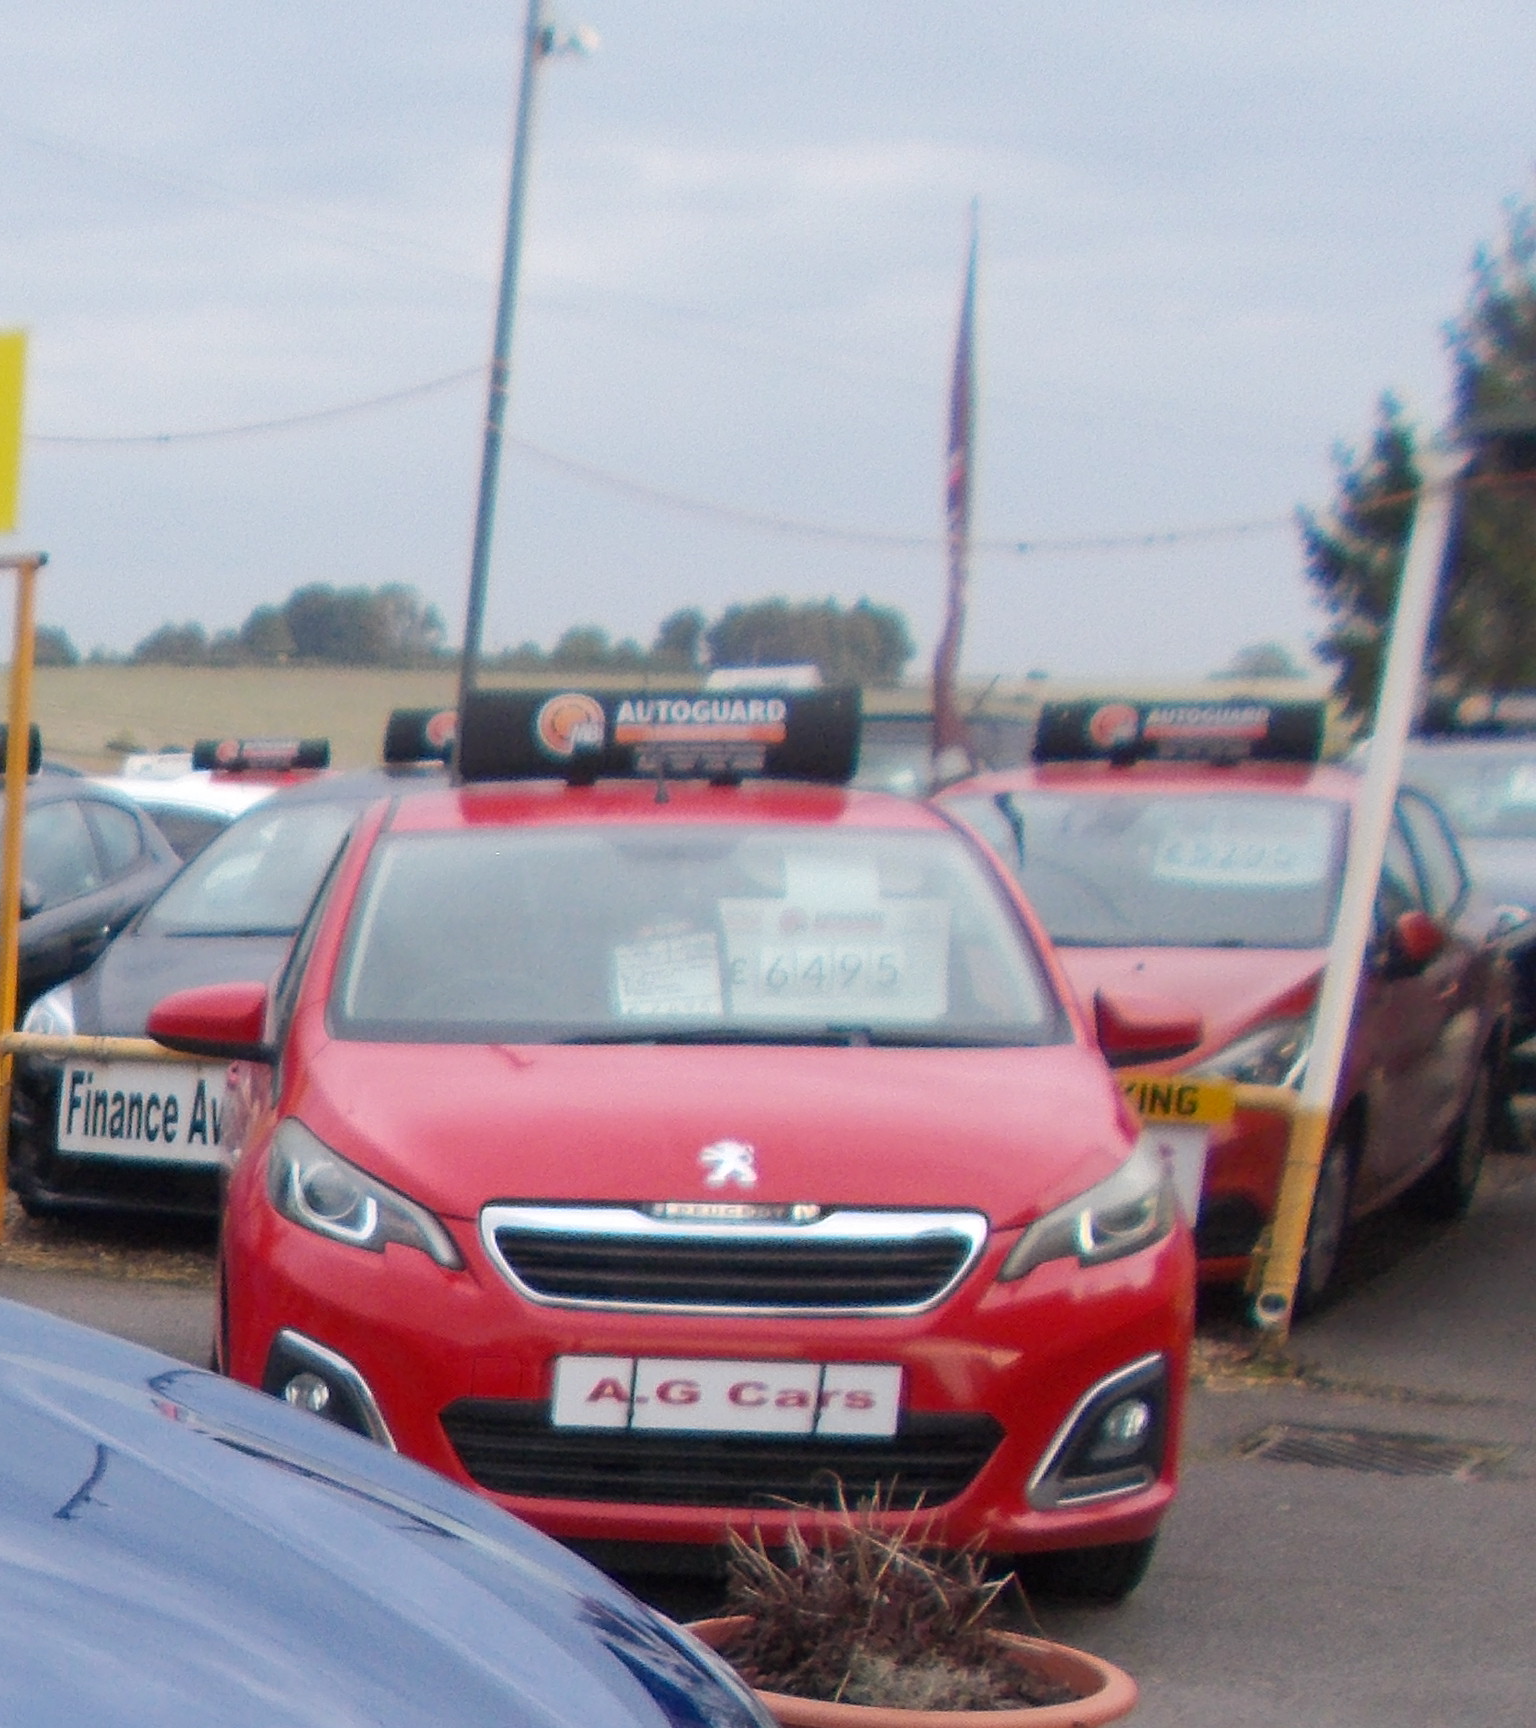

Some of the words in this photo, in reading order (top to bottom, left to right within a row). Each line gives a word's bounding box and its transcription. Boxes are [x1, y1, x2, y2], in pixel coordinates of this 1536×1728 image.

[617, 699, 787, 724] AUTOGUARD
[66, 1069, 180, 1144] Finance
[1126, 1082, 1199, 1116] ING
[726, 1379, 877, 1411] Cars
